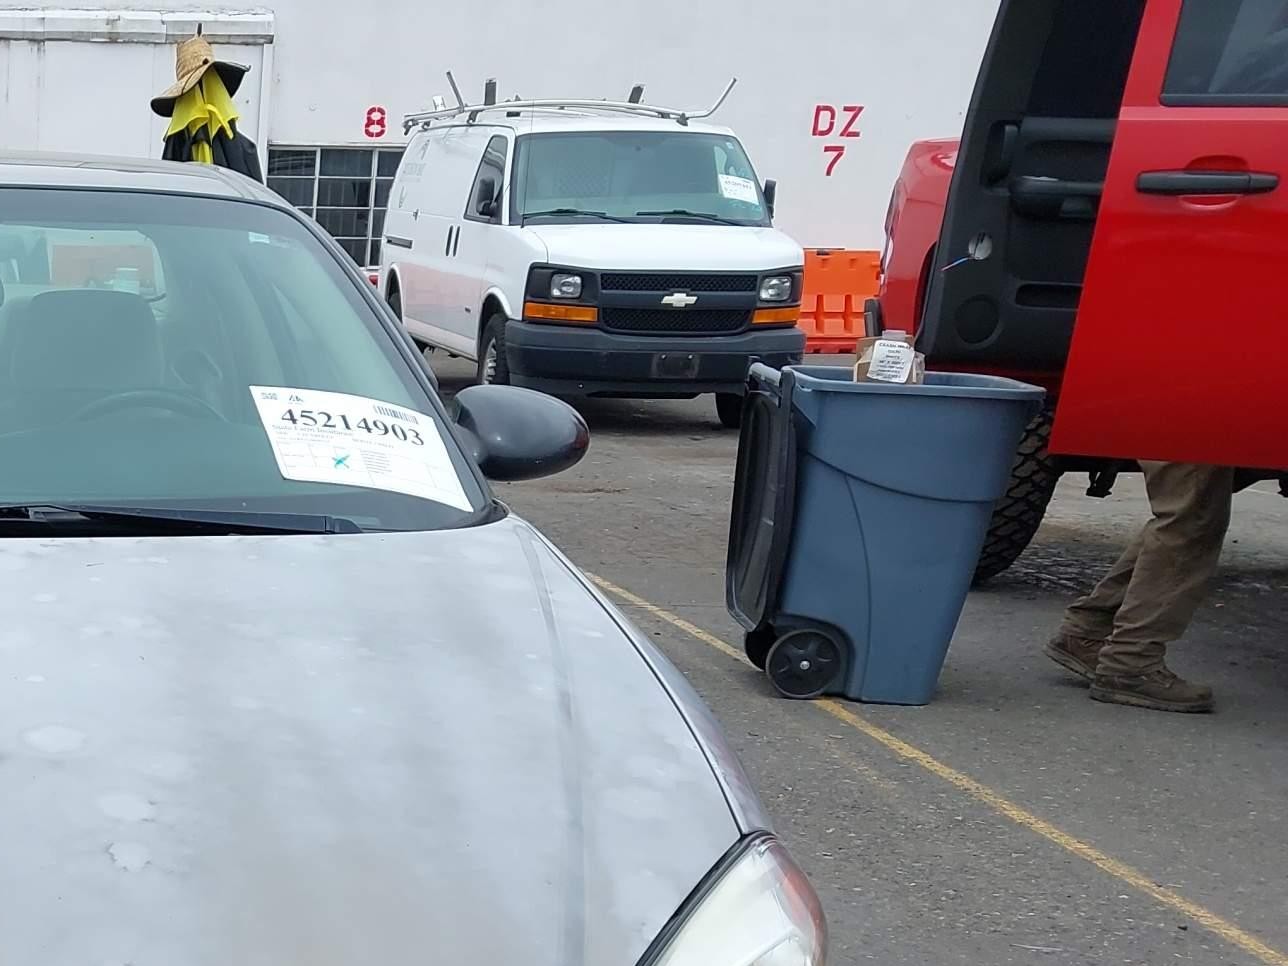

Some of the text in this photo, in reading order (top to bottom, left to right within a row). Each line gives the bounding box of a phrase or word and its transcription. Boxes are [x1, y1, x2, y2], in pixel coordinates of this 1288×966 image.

[364, 106, 386, 138] 8
[811, 104, 865, 138] DZ
[823, 145, 845, 177] 7
[281, 408, 425, 446] 45214903
